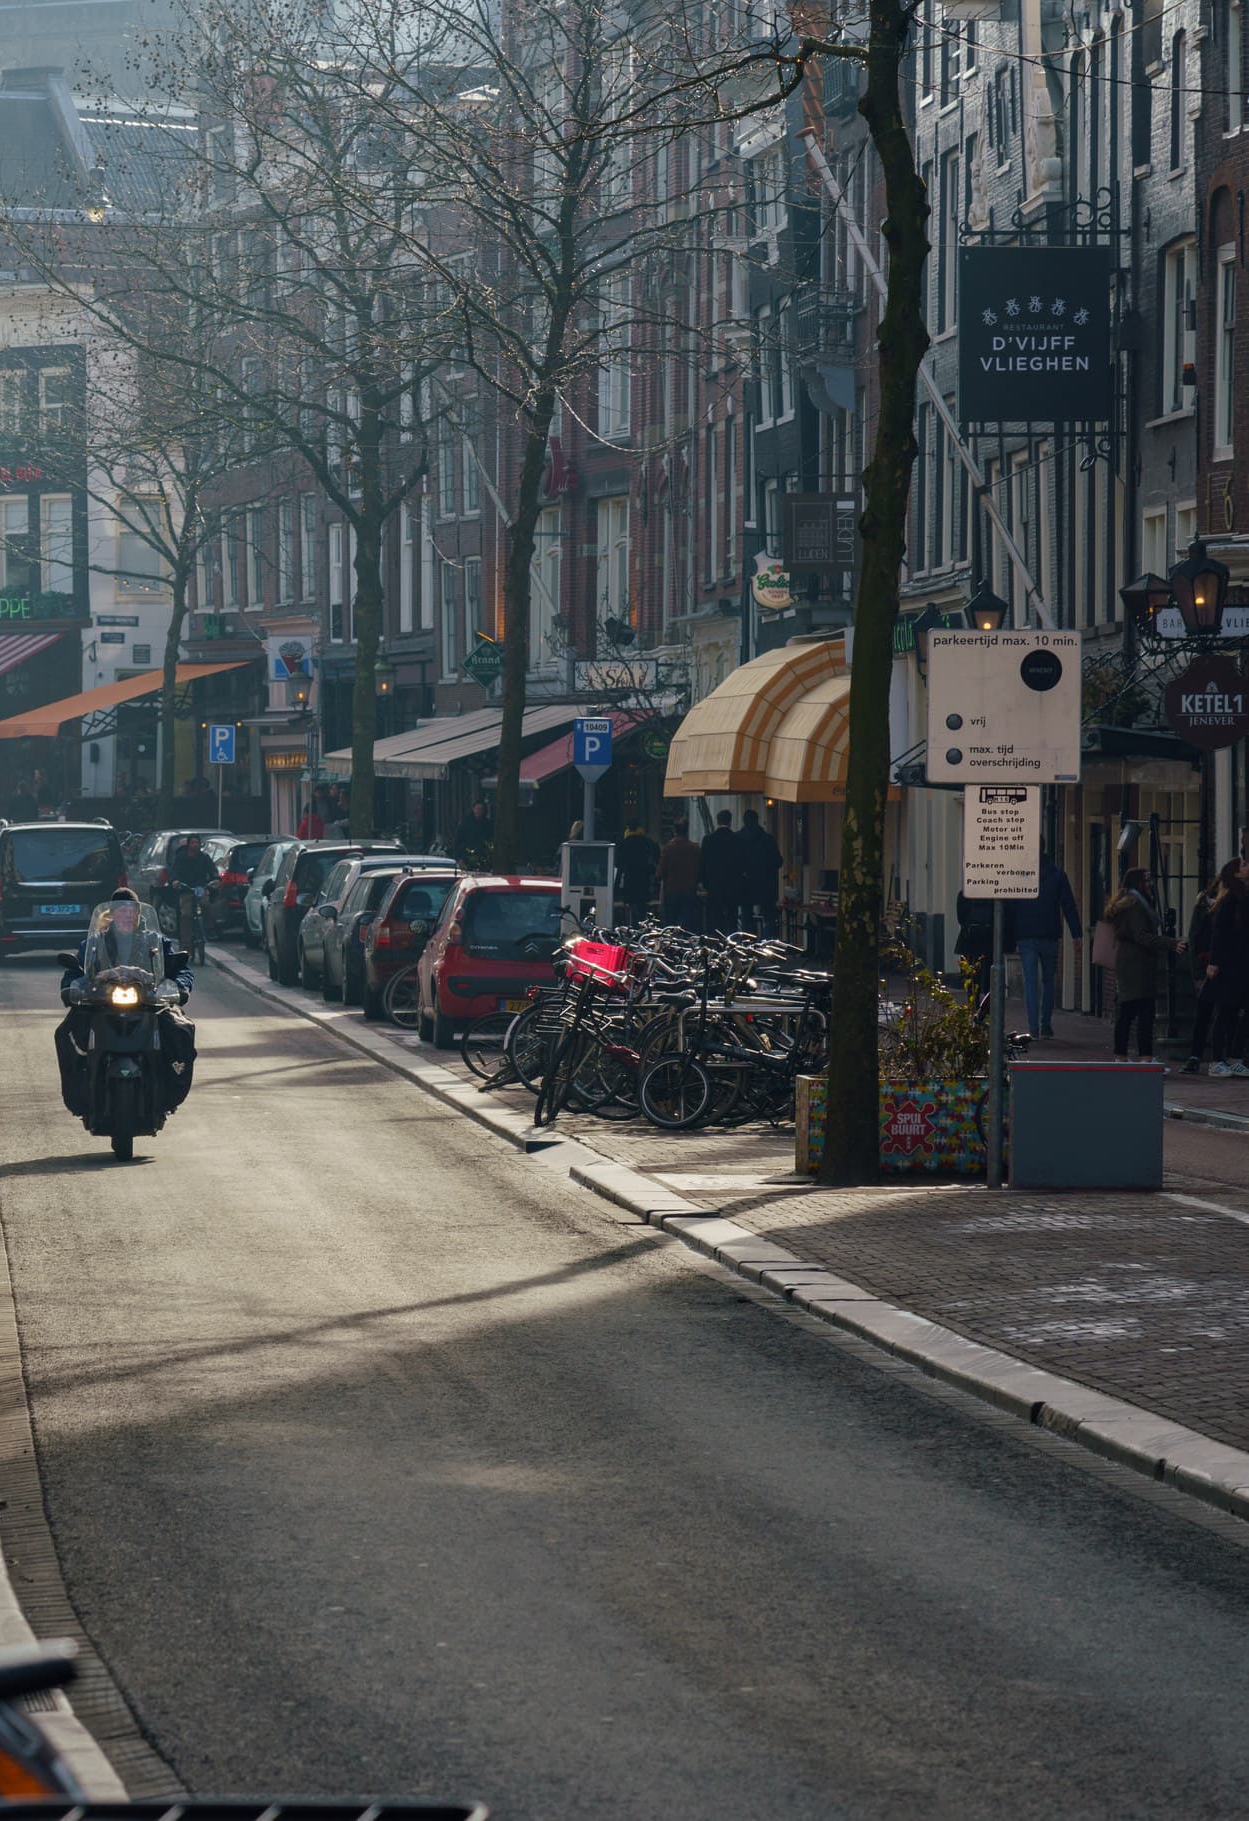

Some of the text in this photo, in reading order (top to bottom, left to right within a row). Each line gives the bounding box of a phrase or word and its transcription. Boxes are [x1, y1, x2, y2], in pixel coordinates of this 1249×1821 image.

[992, 336, 1075, 351] D'VIJFF
[980, 356, 1089, 371] VLIEGHEN
[933, 634, 1078, 648] parkeertijd max. 10 min.
[585, 722, 608, 731] 10409
[970, 716, 986, 728] vrij
[1189, 716, 1236, 727] JENEVER
[215, 727, 230, 747] P
[585, 736, 601, 761] P
[969, 744, 1014, 755] max. tijd
[969, 758, 1041, 769] overschrijding
[1006, 817, 1025, 825] stop
[897, 1113, 921, 1124] SPUI
[891, 1124, 926, 1136] BUURT
